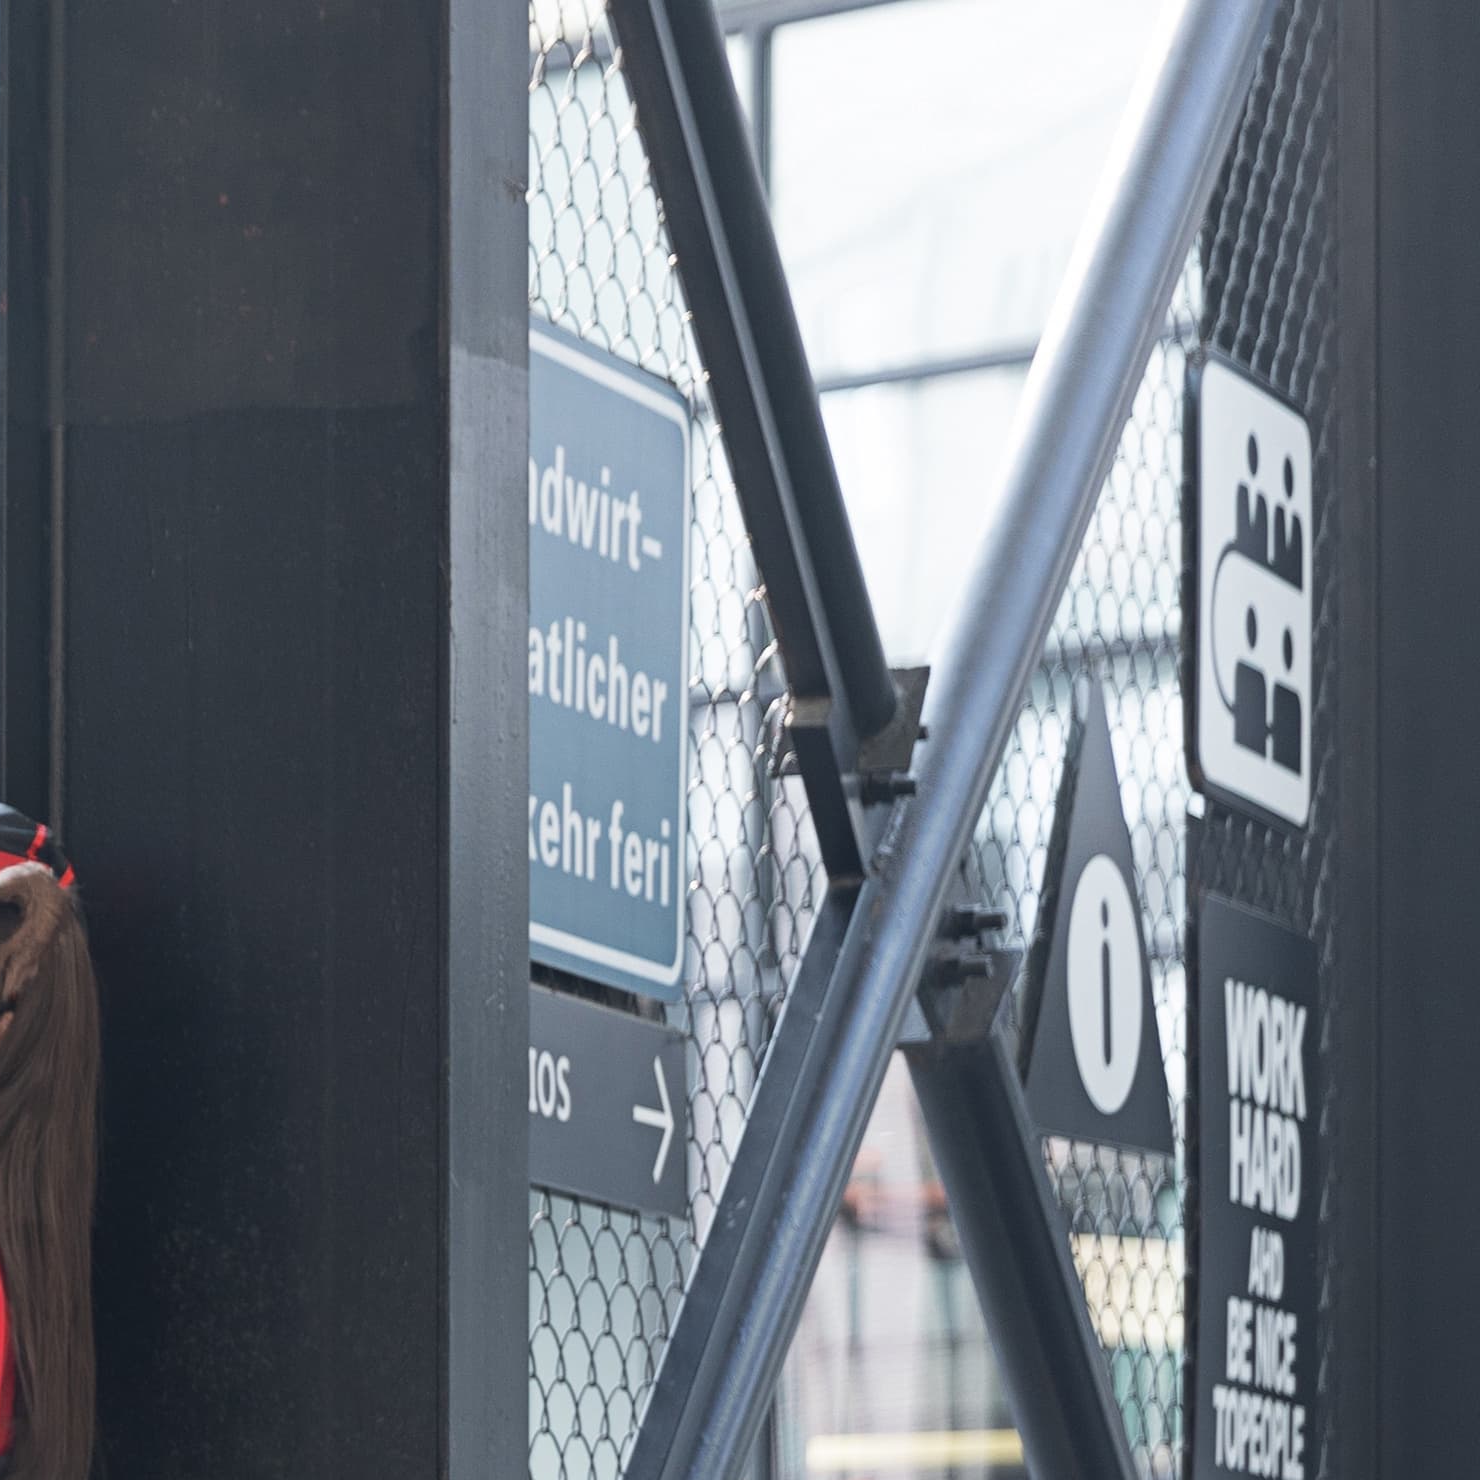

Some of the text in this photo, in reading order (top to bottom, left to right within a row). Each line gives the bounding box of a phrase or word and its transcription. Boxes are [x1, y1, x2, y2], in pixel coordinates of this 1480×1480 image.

[609, 799, 670, 907] feri
[1224, 977, 1307, 1121] WORK
[1230, 1098, 1301, 1222] HARD
[1248, 1225, 1285, 1301] AND
[1226, 1295, 1297, 1396] BE NICE
